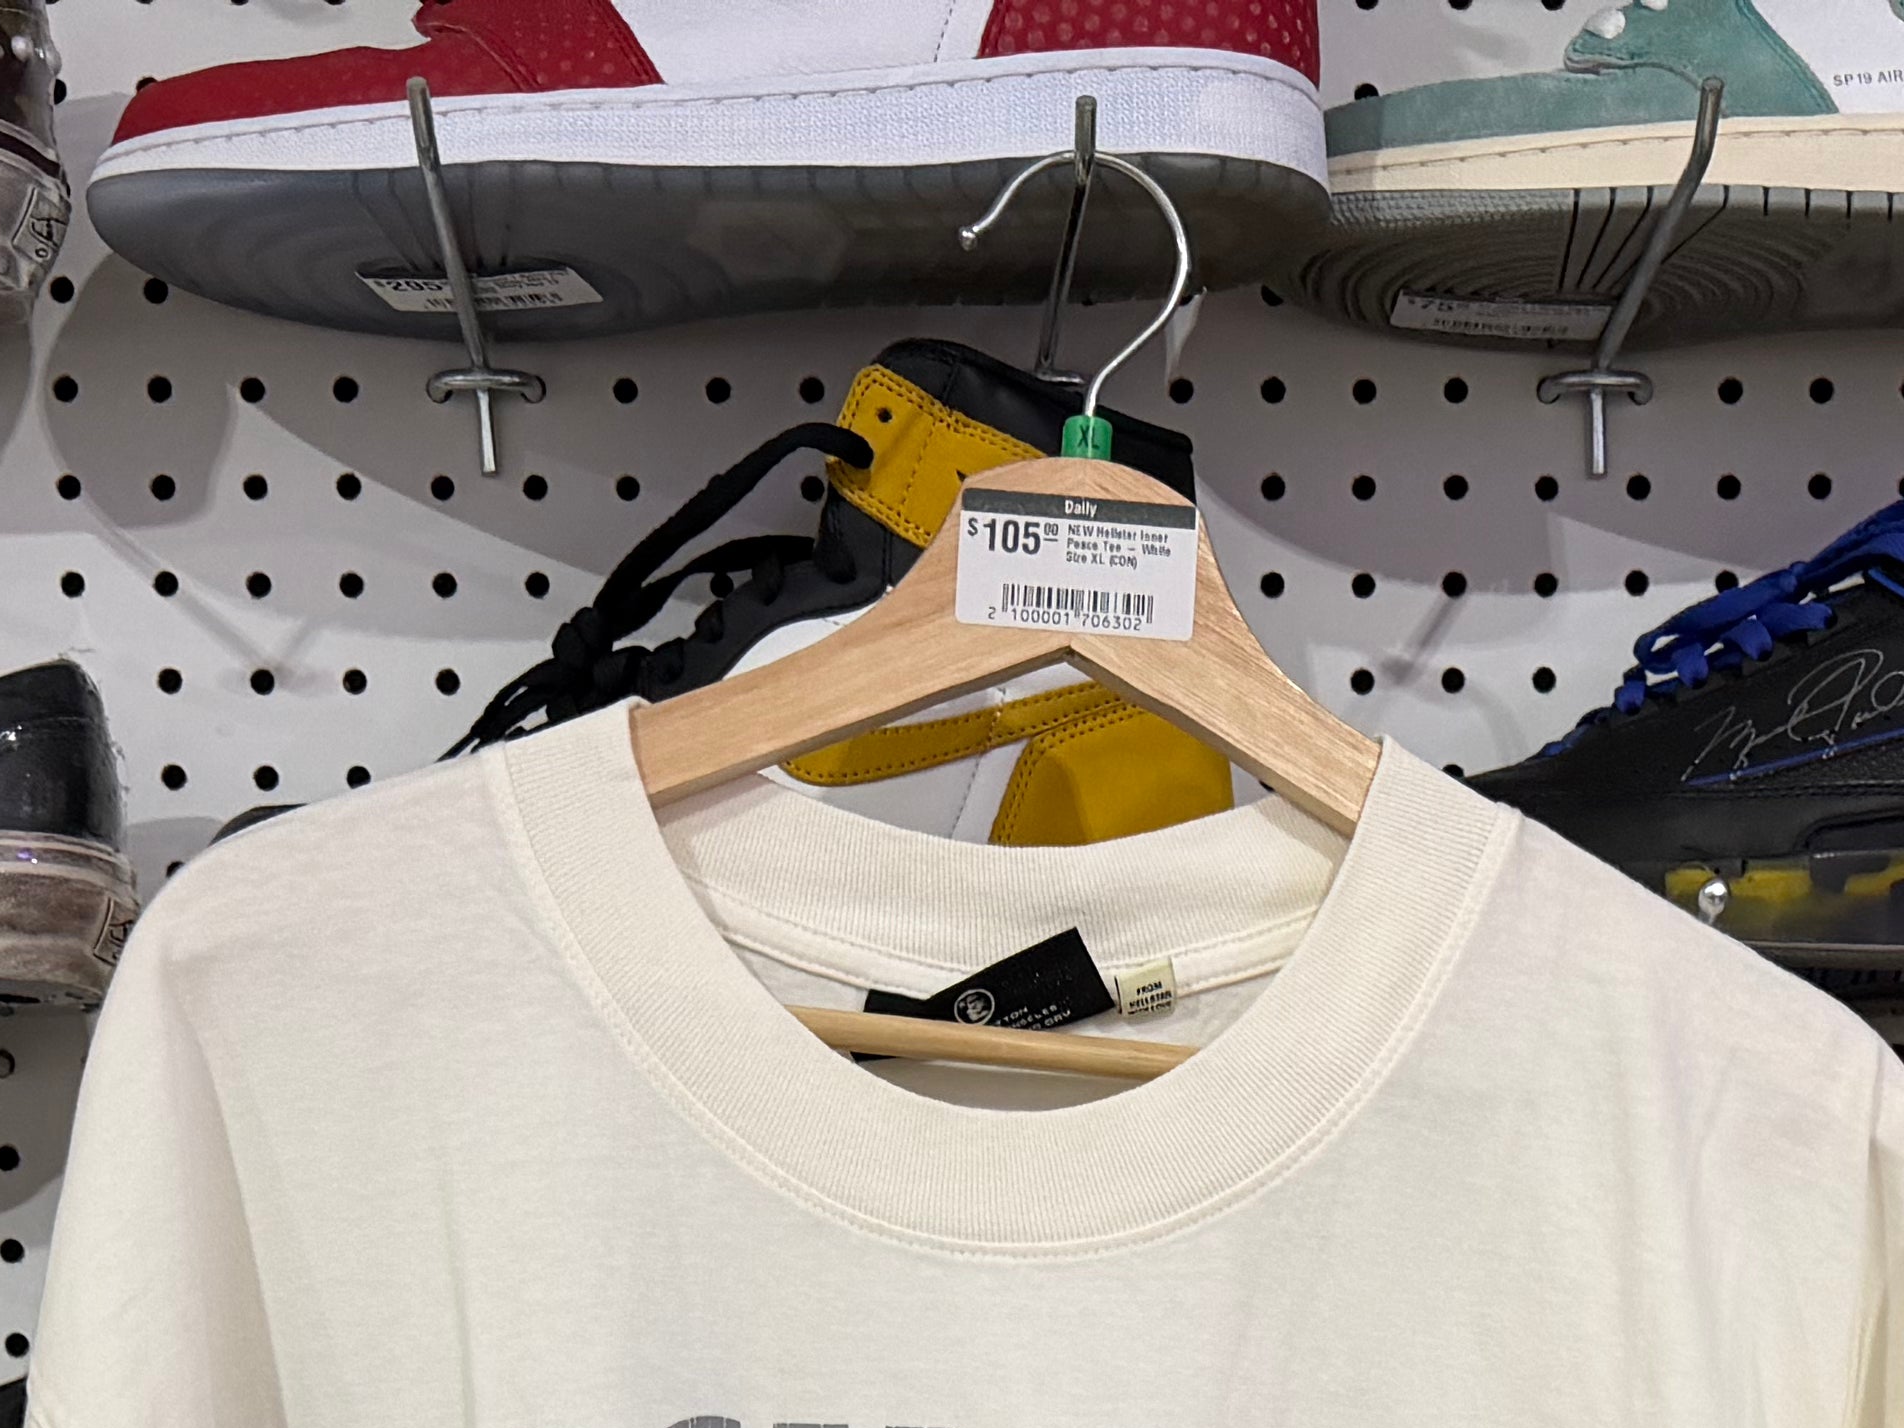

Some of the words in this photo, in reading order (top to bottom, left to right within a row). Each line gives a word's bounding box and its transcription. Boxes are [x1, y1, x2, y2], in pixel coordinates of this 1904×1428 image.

[1877, 69, 1903, 83] AIR
[1077, 424, 1100, 450] XL
[1064, 499, 1098, 519] Daily
[1067, 523, 1094, 537] NEW
[1103, 540, 1122, 553] Tee
[1066, 550, 1088, 565] Size
[1090, 554, 1106, 566] XL
[987, 606, 997, 620] 2
[1011, 607, 1071, 627] 100001
[1081, 612, 1143, 632] 706302
